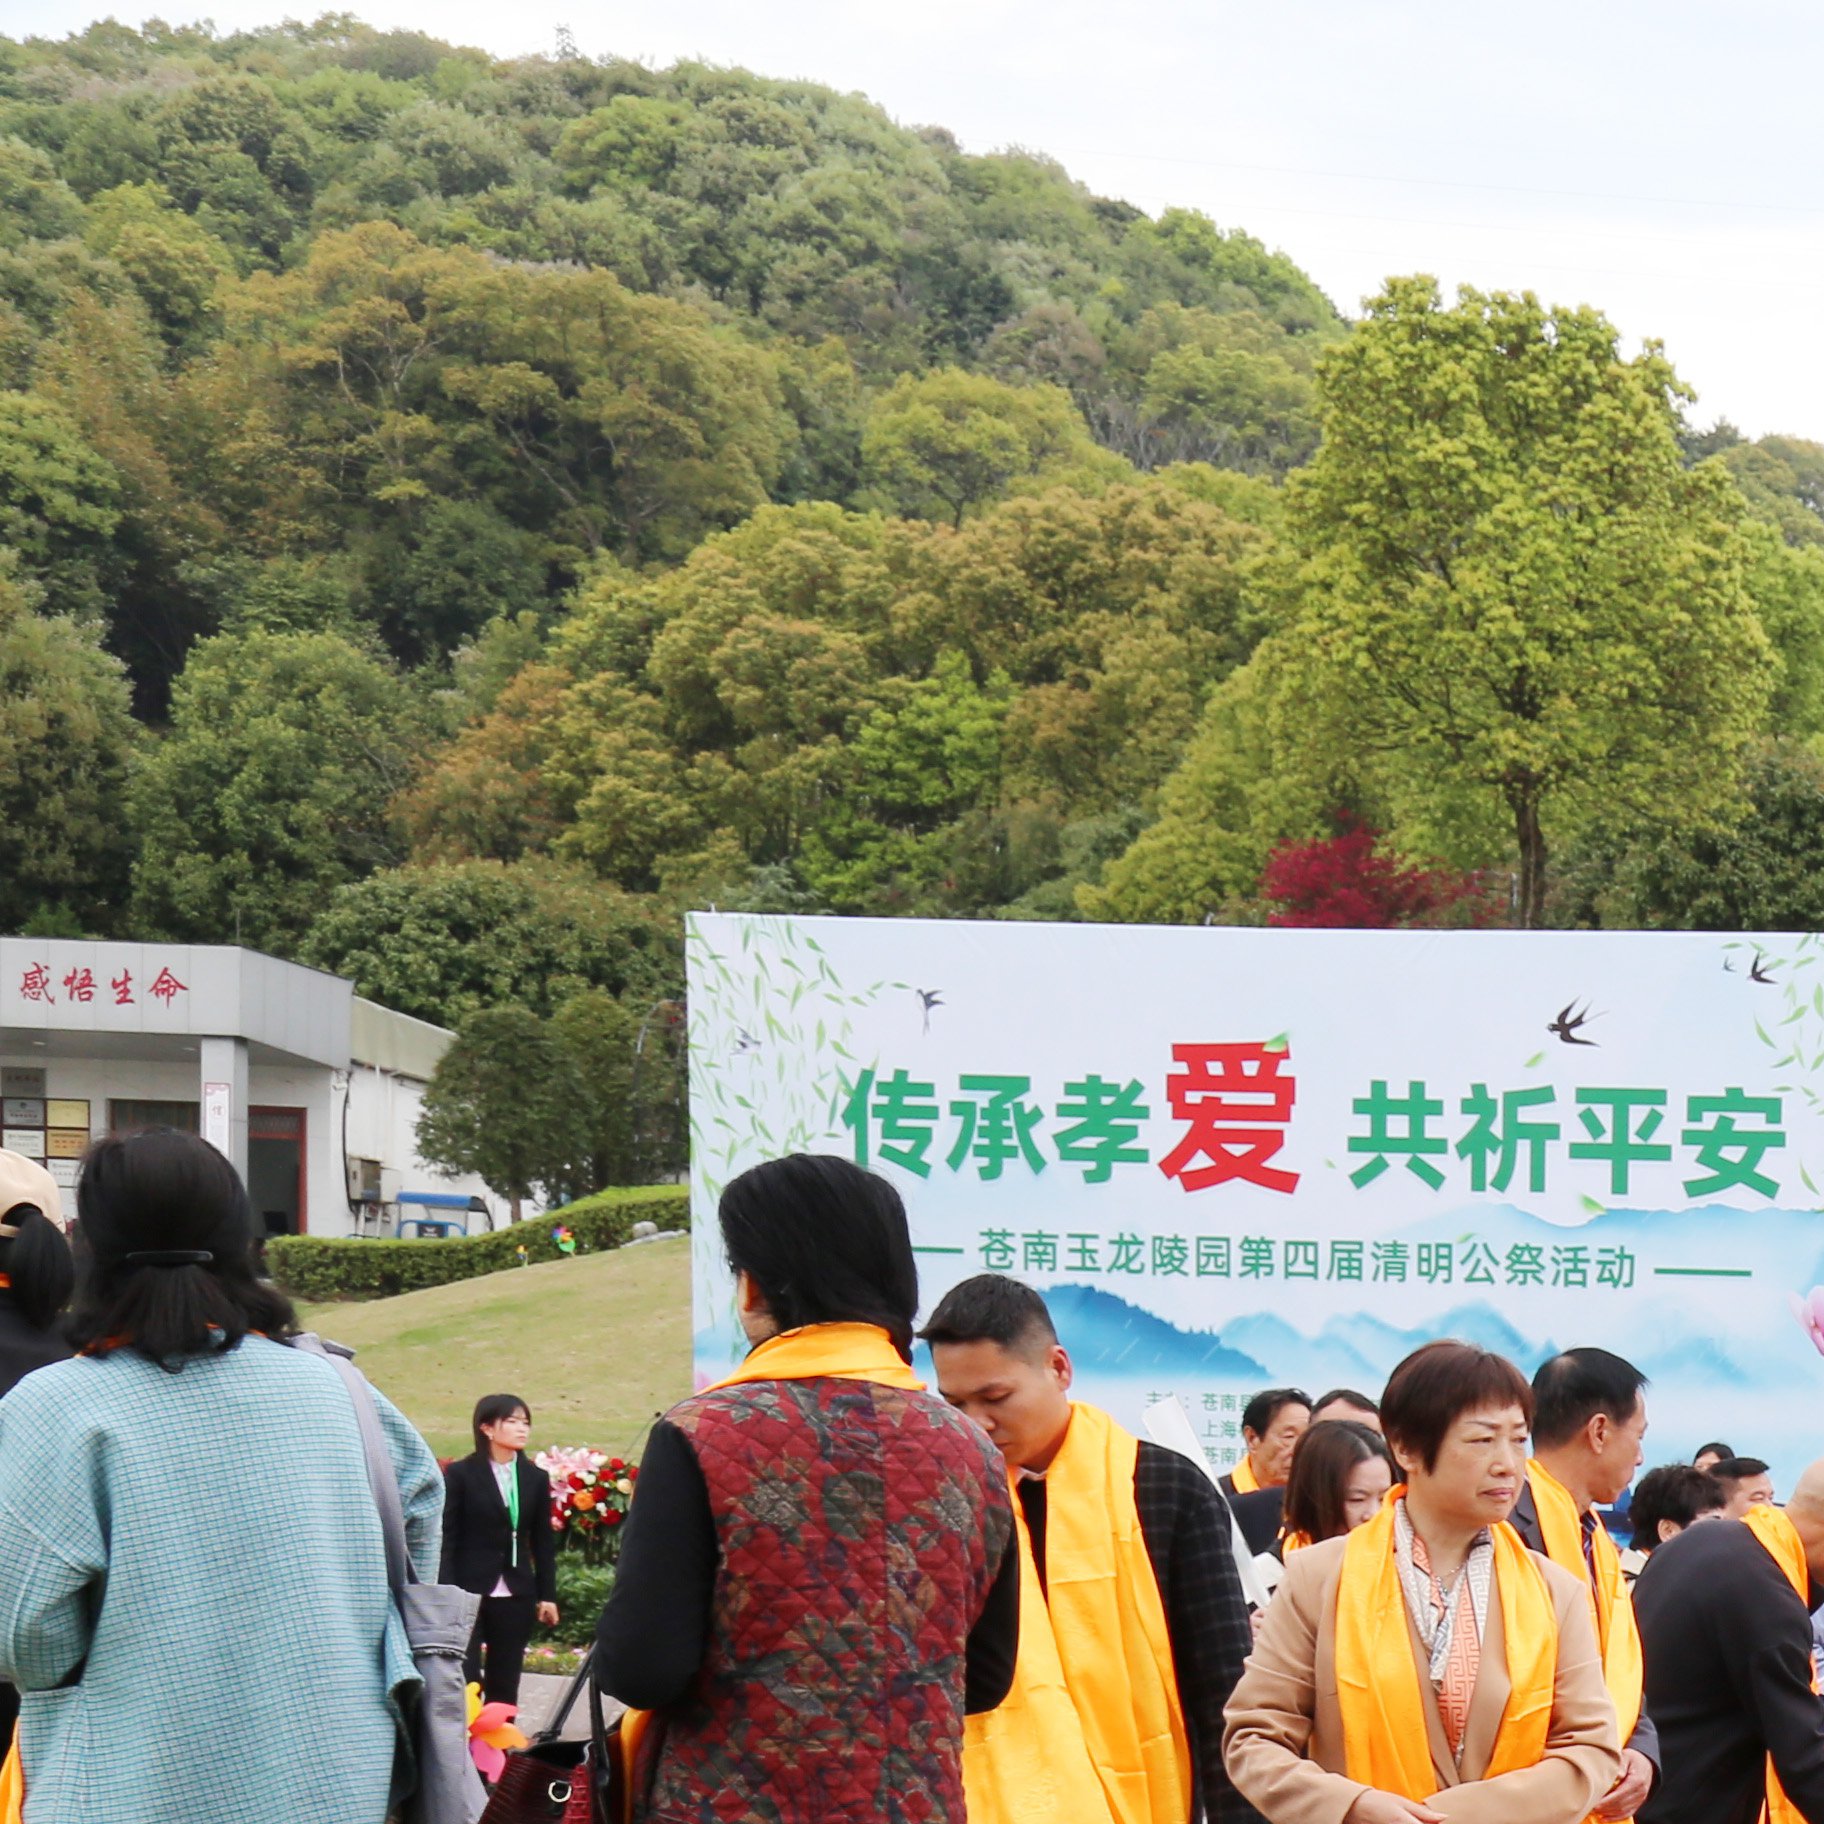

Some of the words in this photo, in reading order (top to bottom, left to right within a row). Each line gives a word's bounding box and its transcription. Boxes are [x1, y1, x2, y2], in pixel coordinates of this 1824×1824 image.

[20, 961, 190, 1009] 感悟生命
[841, 1041, 1300, 1194] 传承孝爱
[1346, 1079, 1787, 1200] 共祈平安
[978, 1228, 1637, 1290] 苍南玉龙陵园第四届清明公祭活动
